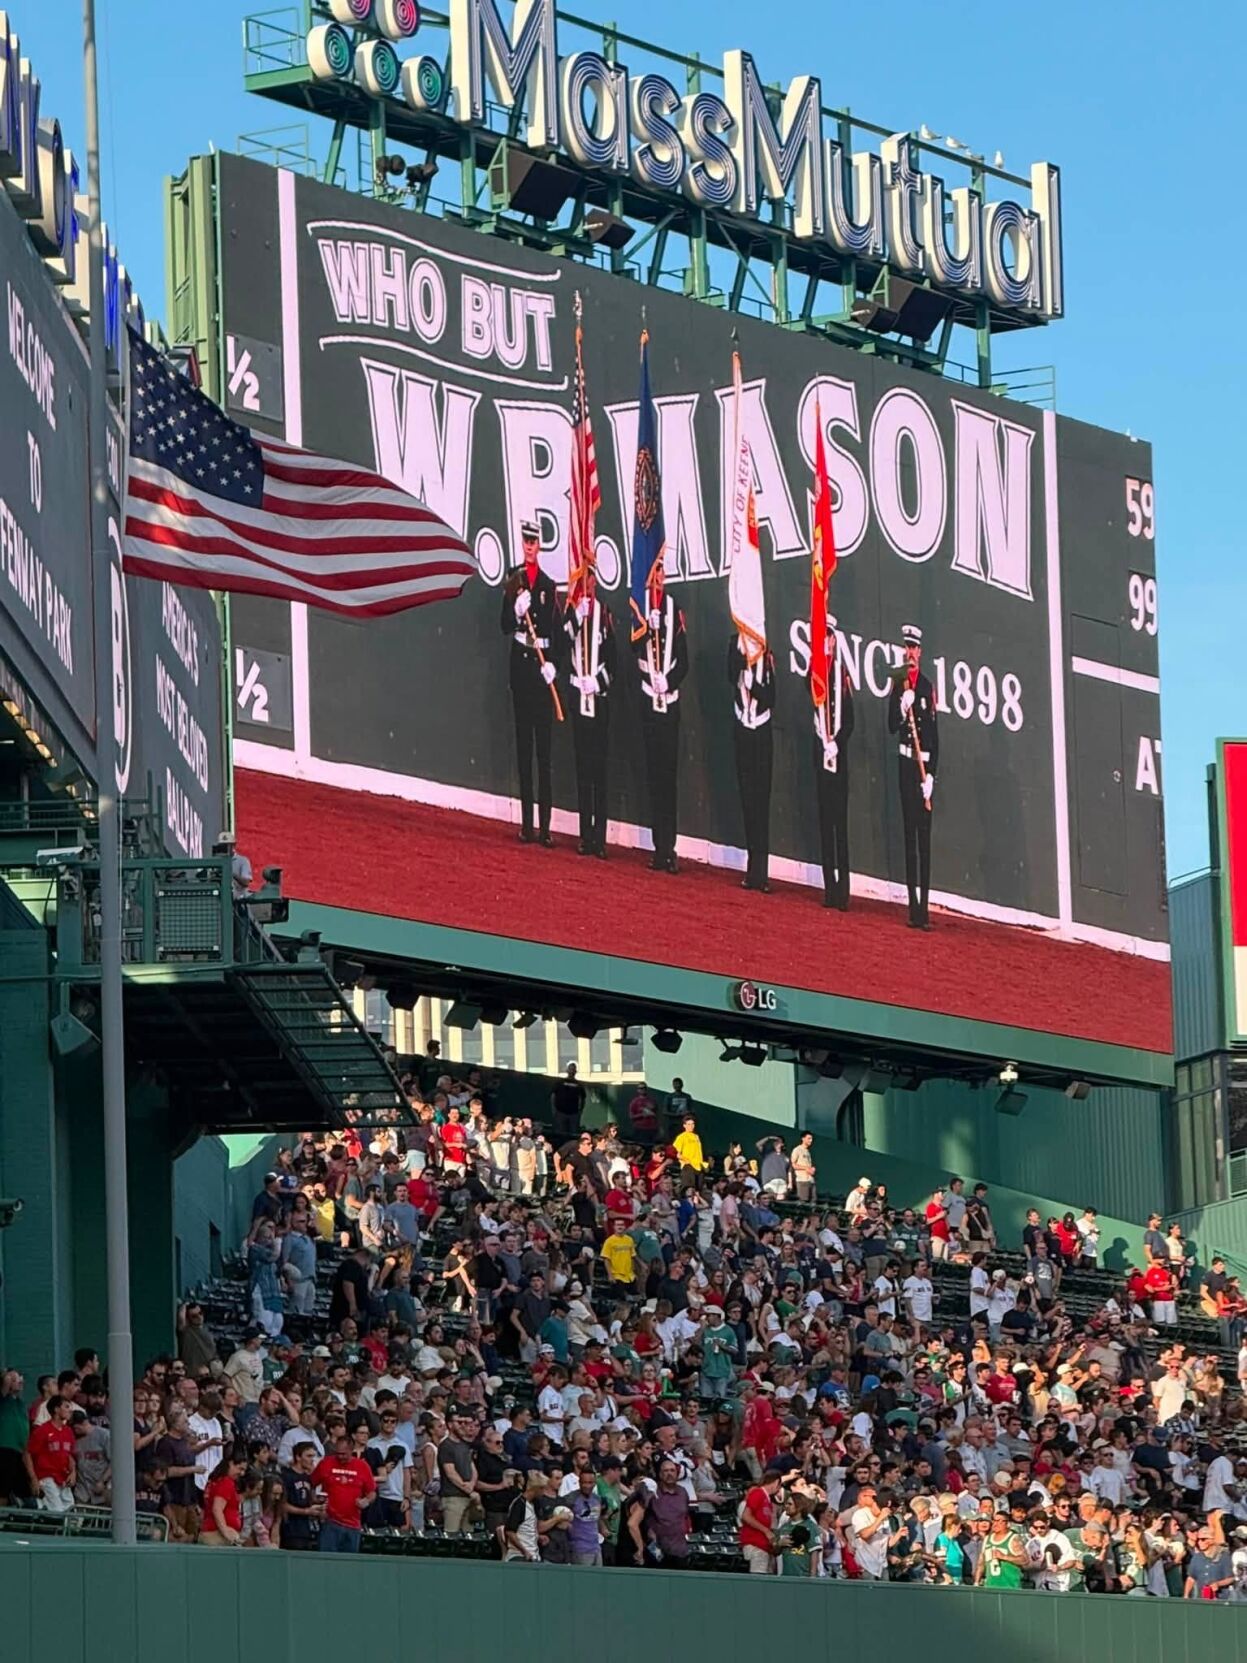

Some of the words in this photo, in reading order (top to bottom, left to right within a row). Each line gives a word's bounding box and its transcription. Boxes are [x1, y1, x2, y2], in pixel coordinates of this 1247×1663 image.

[449, 0, 1064, 318] MassMutual
[7, 281, 56, 431] WELCOME
[317, 238, 447, 344] WHO
[461, 273, 556, 372] BUT
[27, 431, 42, 513] TO
[1125, 478, 1155, 539] 59
[0, 498, 43, 628] FENWAY
[46, 571, 73, 674] PARK
[1129, 574, 1158, 636] 99
[156, 653, 176, 741] MOST
[177, 689, 208, 793] BELOVED
[789, 619, 908, 698] SNC
[933, 656, 1024, 732] 1898
[758, 988, 777, 1010] LG
